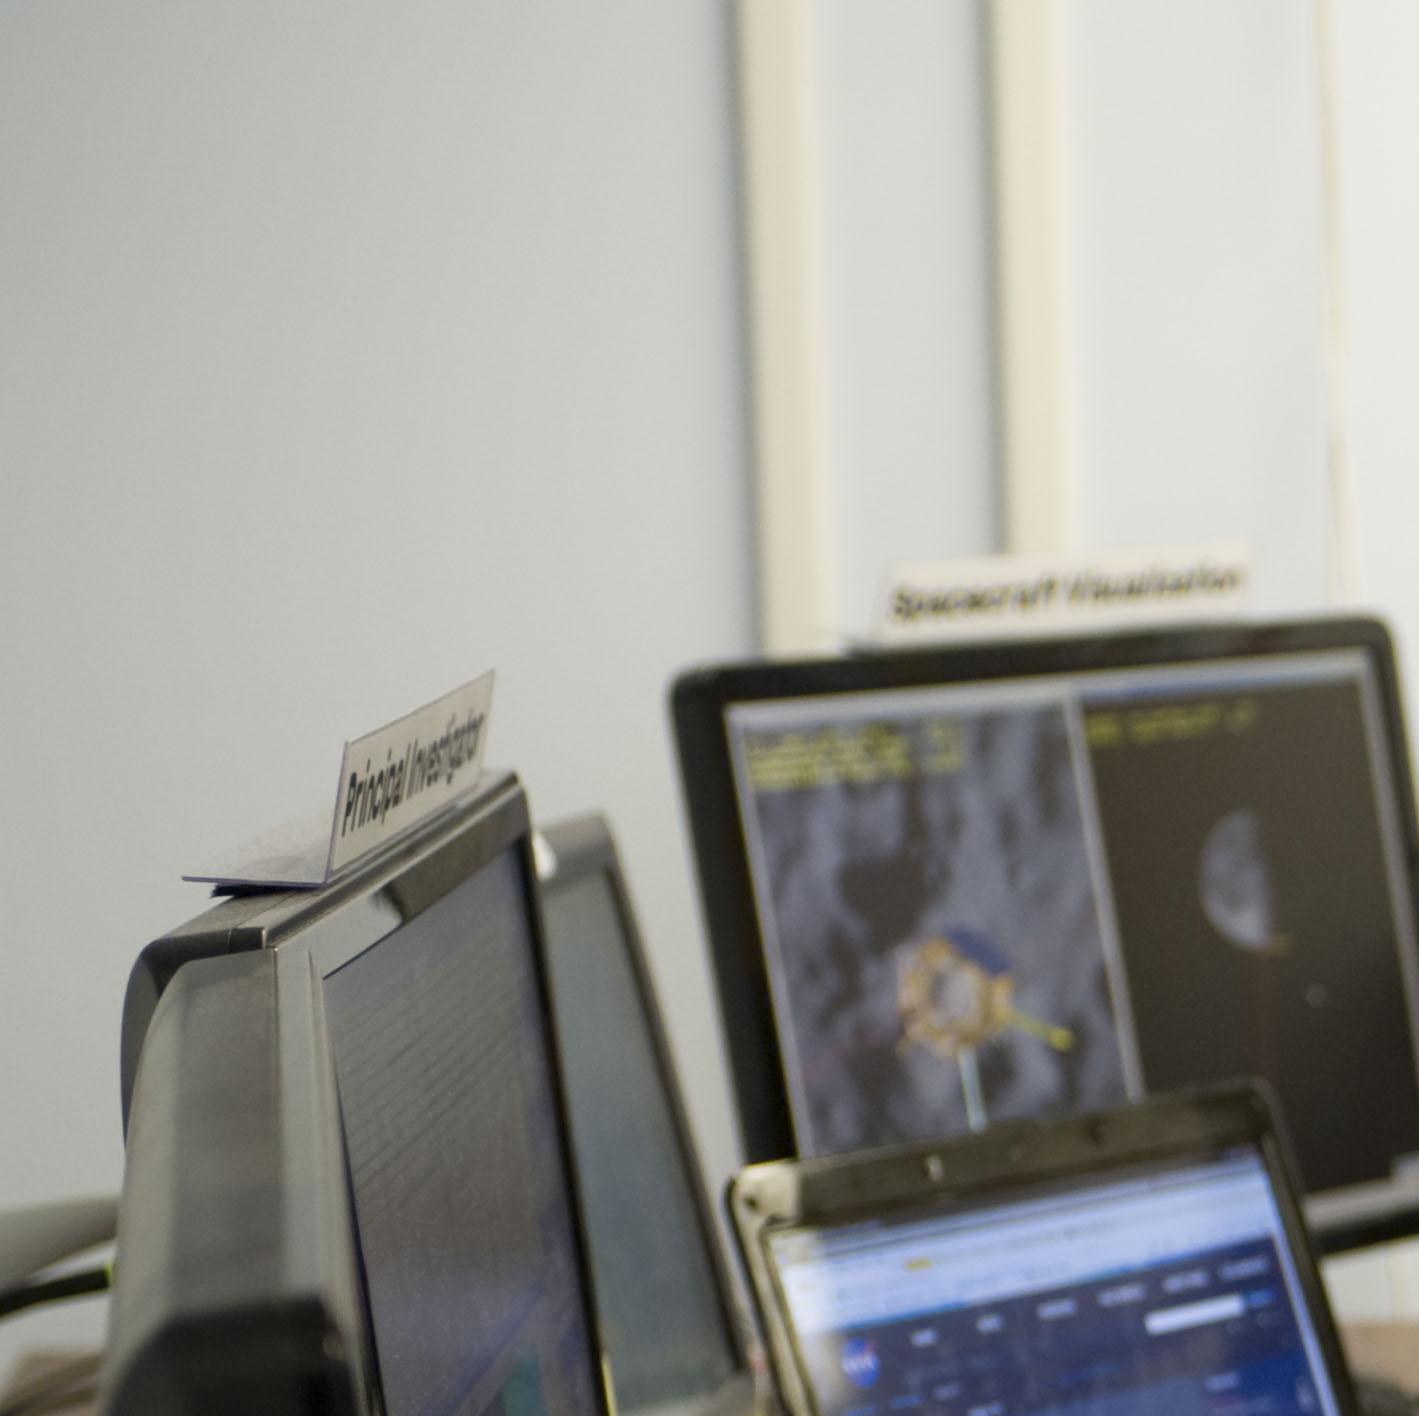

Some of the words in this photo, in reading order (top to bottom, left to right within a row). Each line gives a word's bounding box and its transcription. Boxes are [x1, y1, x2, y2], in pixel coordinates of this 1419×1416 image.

[891, 574, 1057, 622] Spacecraft
[341, 740, 411, 838] Principal
[406, 707, 484, 800] Investigator
